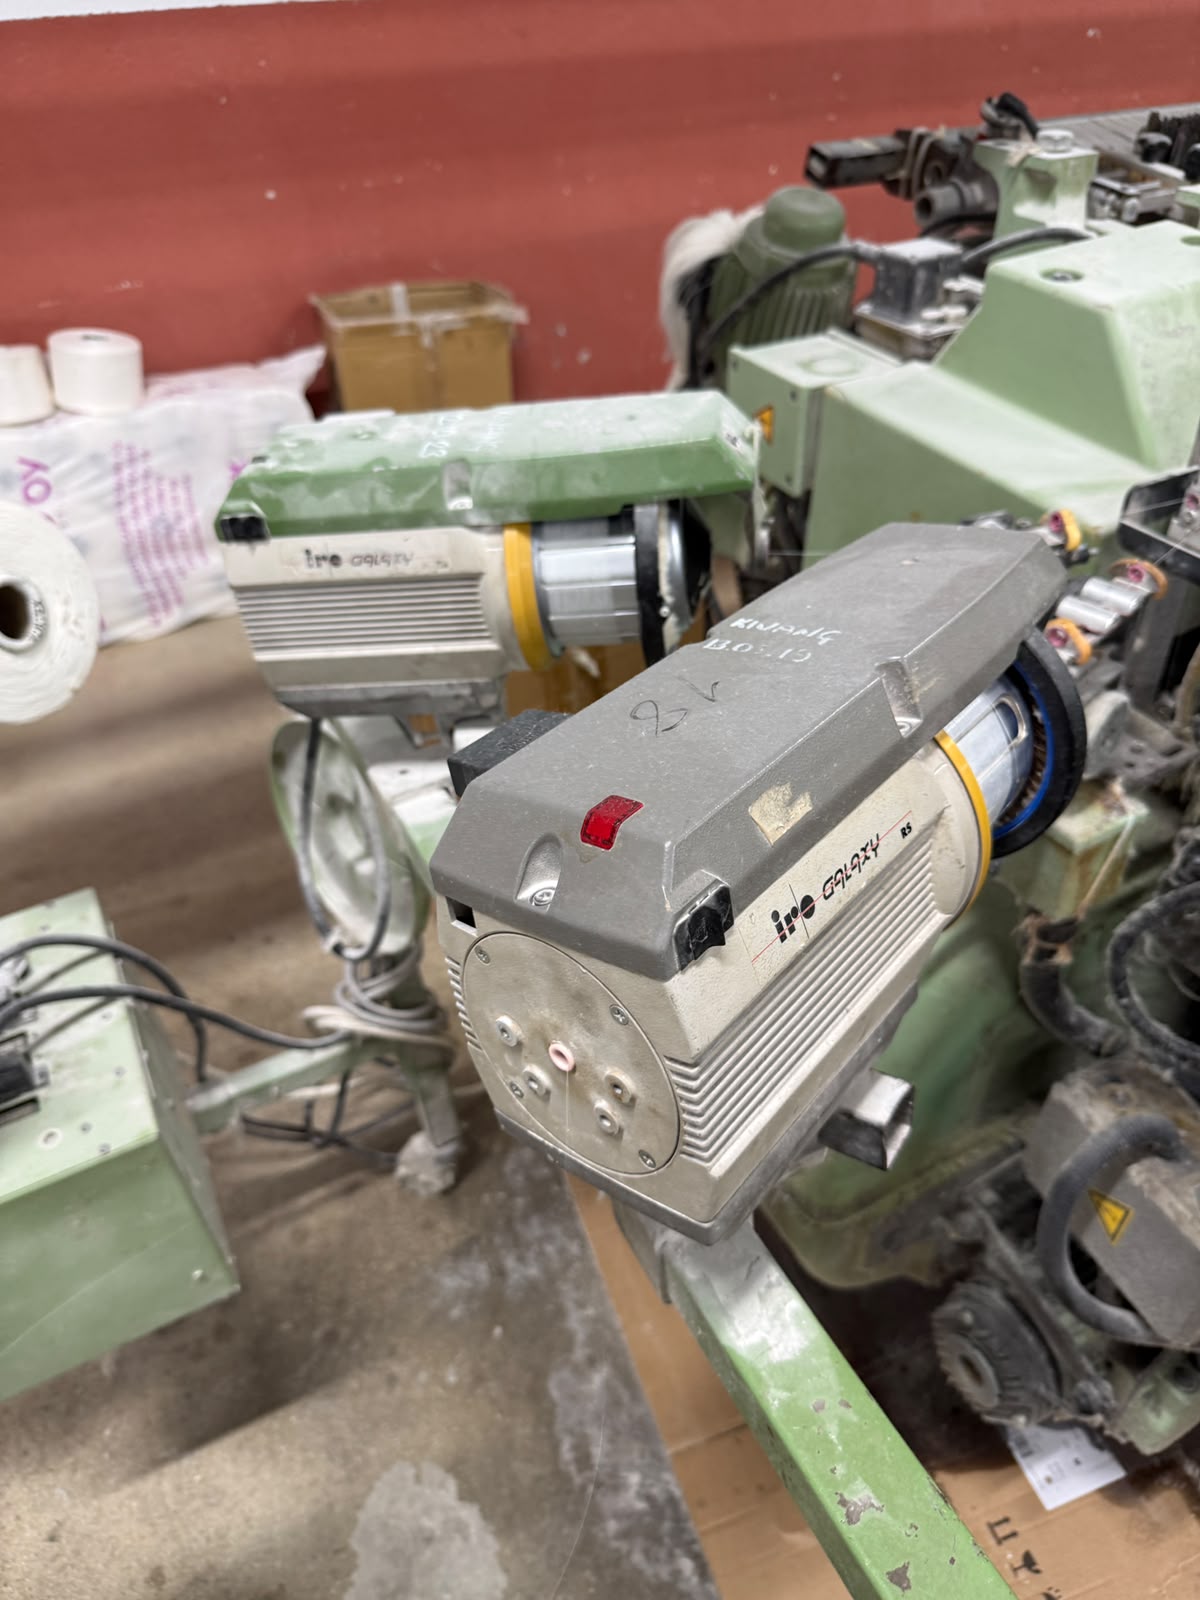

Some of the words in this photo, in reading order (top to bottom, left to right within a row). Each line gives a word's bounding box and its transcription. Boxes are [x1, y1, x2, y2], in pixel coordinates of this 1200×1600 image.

[17, 456, 56, 521] OY
[771, 894, 815, 943] iro
[822, 833, 880, 900] GALAXY
[900, 822, 912, 839] RS
